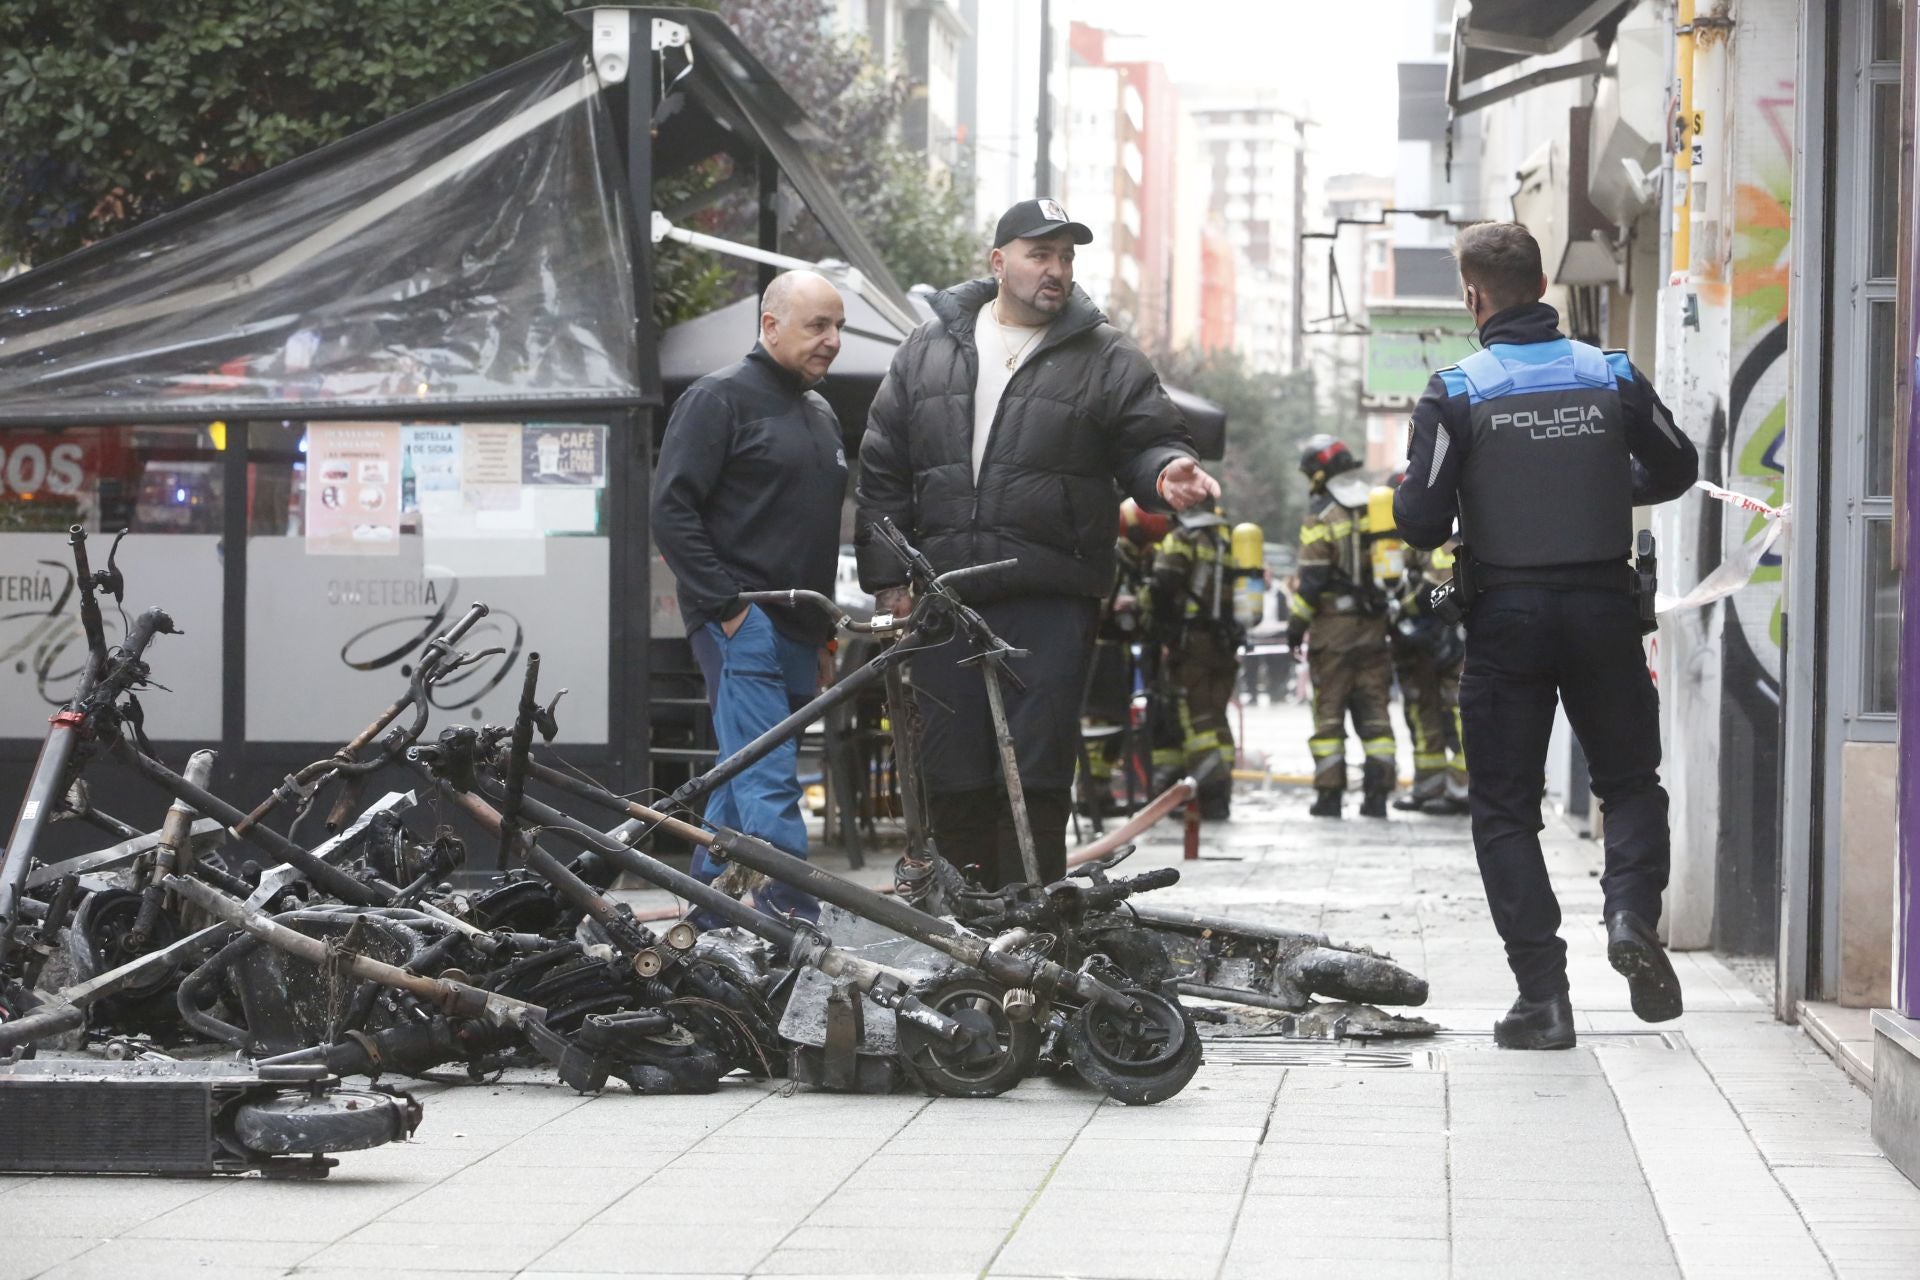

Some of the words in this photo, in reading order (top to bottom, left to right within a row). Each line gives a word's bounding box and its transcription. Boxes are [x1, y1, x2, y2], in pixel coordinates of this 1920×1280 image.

[413, 431, 453, 441] BOTELLA
[560, 429, 595, 448] CAFÉ
[1530, 422, 1606, 440] LOCAL
[413, 445, 424, 454] DE
[427, 444, 453, 454] SIDRA
[0, 443, 84, 496] OS
